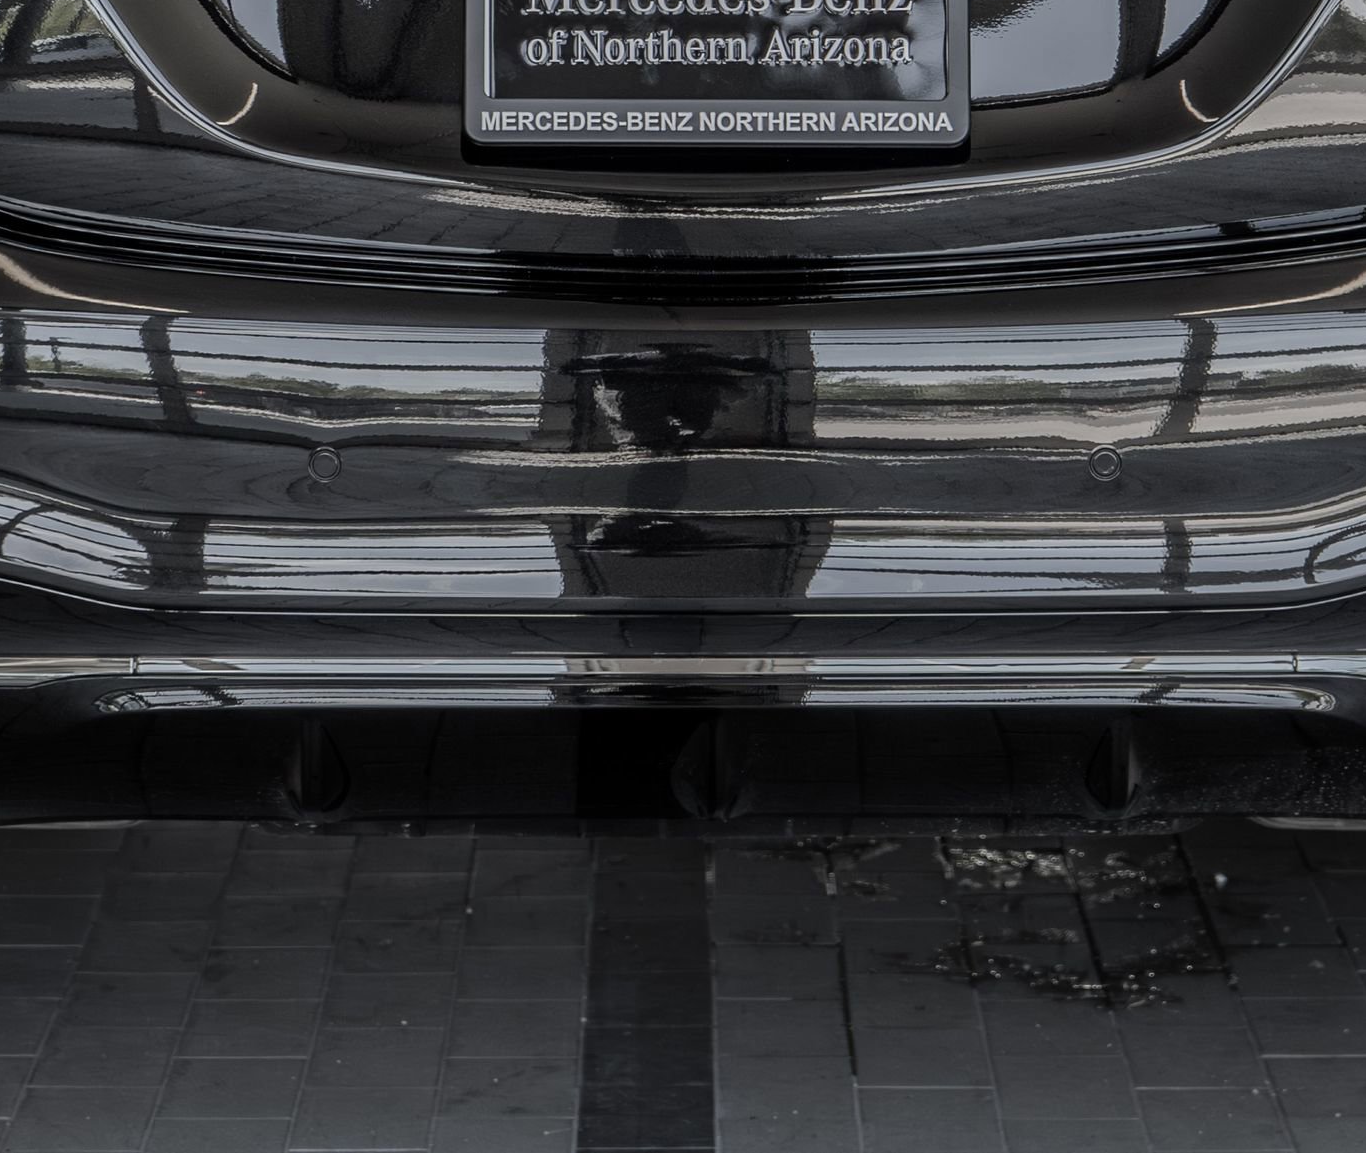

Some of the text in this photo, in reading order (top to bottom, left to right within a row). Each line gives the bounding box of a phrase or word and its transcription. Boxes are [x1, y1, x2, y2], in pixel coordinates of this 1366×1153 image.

[523, 29, 912, 66] of Northern Arizona
[481, 111, 953, 132] MERCEDES-BENZ NORTHERN ARIZONA
